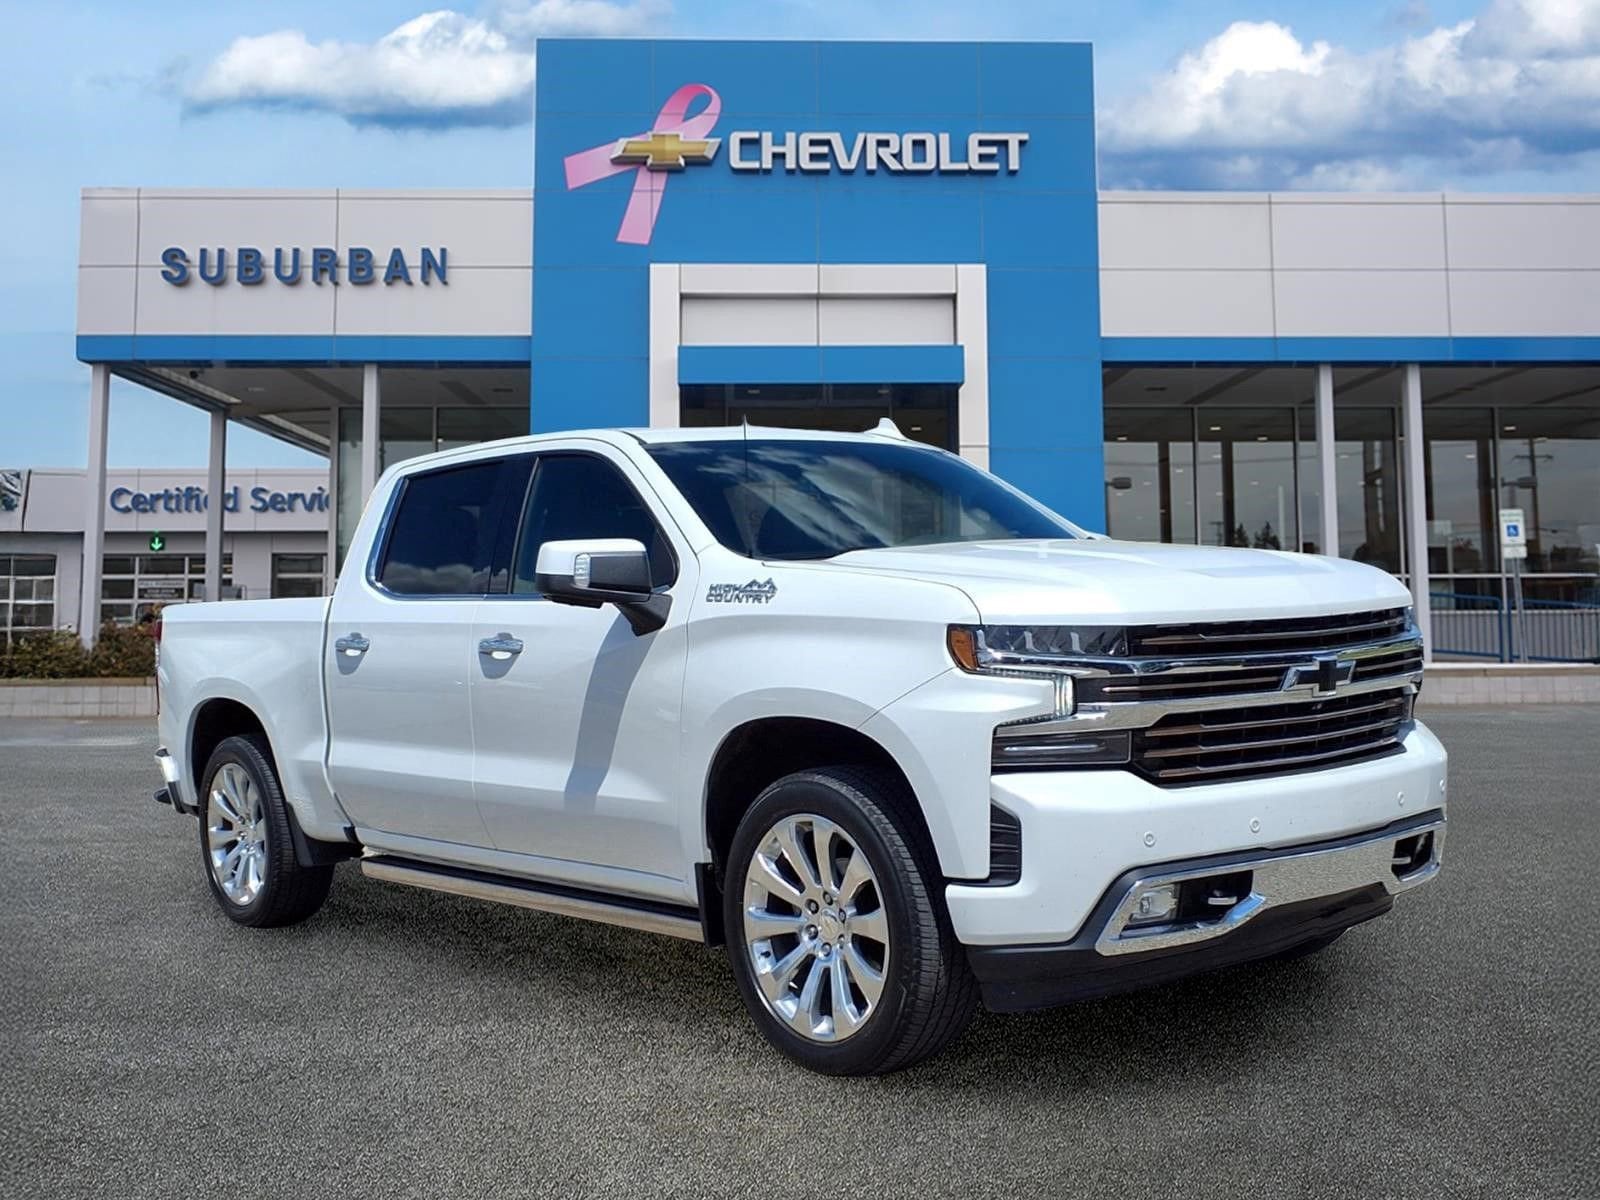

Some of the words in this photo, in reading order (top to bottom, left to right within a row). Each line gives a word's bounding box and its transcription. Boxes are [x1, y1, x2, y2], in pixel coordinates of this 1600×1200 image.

[729, 131, 1029, 172] CHEVROLET
[161, 247, 448, 286] SUBURBAN
[110, 486, 240, 513] Certifid
[705, 593, 776, 604] COUNTRY
[709, 583, 743, 594] HIGH
